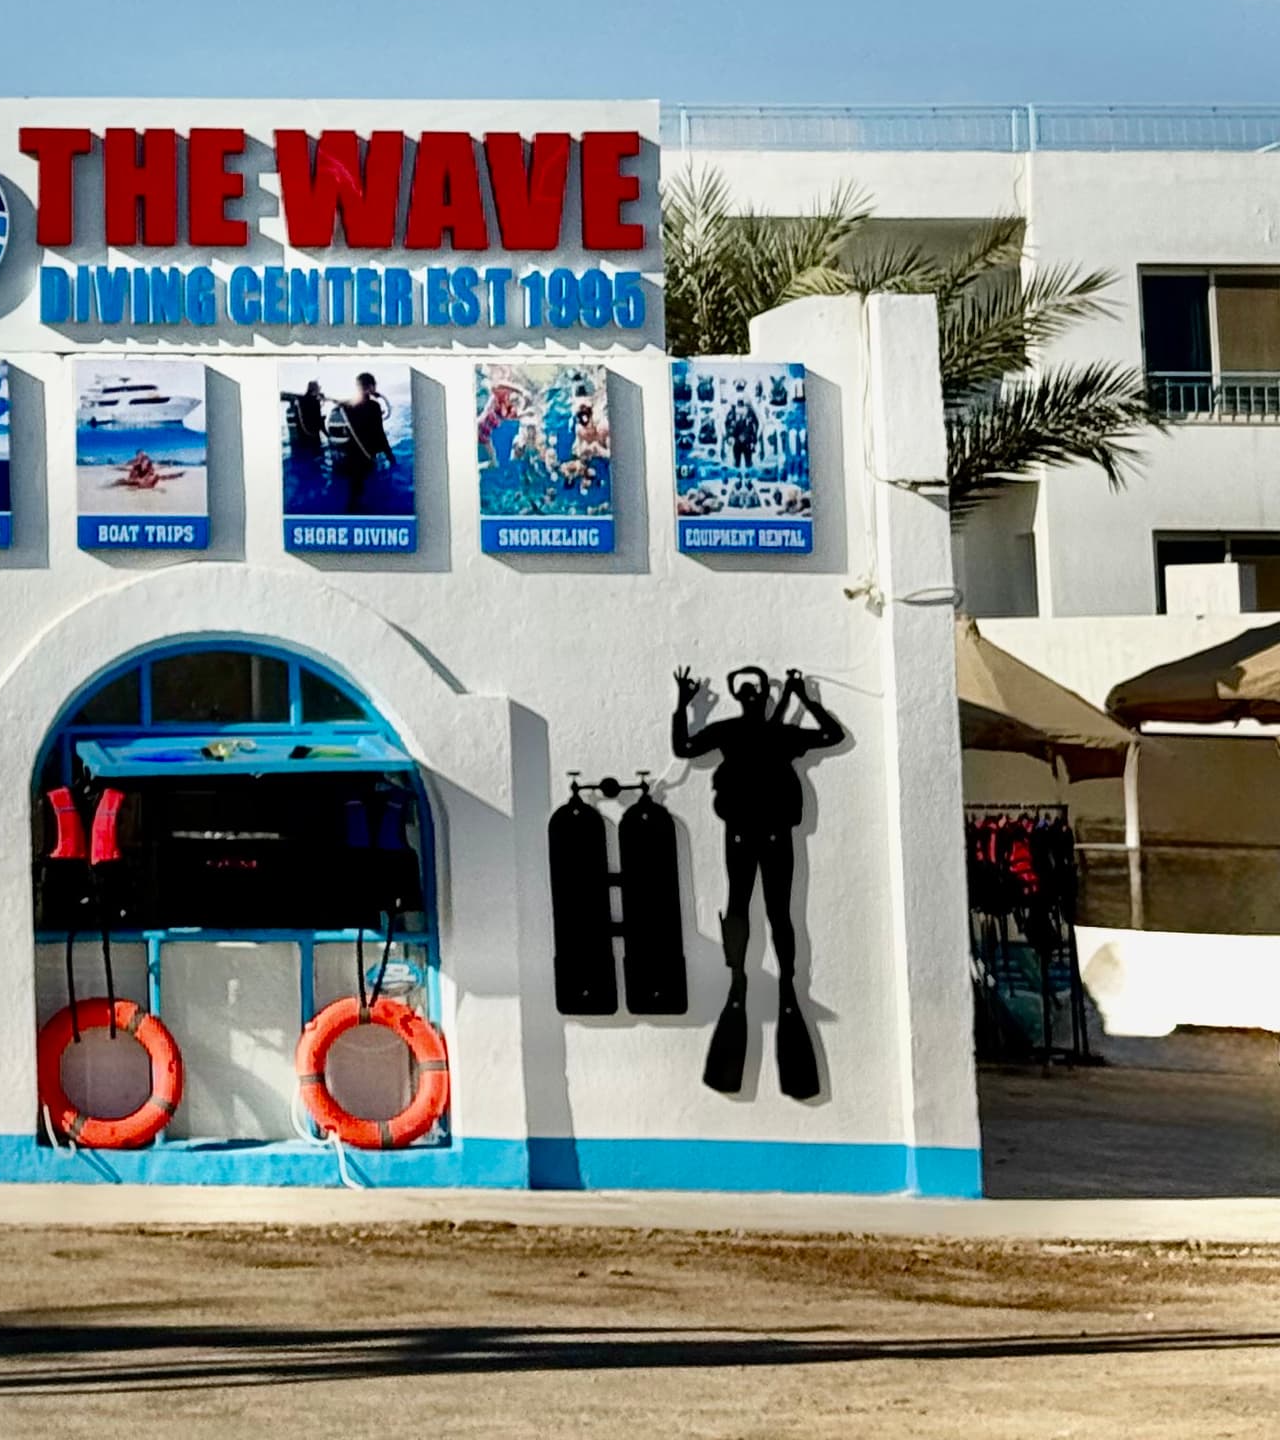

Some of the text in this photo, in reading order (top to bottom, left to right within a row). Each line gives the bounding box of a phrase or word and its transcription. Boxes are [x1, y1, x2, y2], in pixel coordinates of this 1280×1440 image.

[19, 127, 645, 250] THE WAVE
[40, 266, 647, 328] DIVING CENTER EST 1995
[98, 525, 194, 543] BOAT TRIPS
[293, 527, 410, 546] SHORE DIVING
[498, 528, 600, 547] SNORKELING
[685, 528, 806, 548] EQUIPMENT RENTAL
